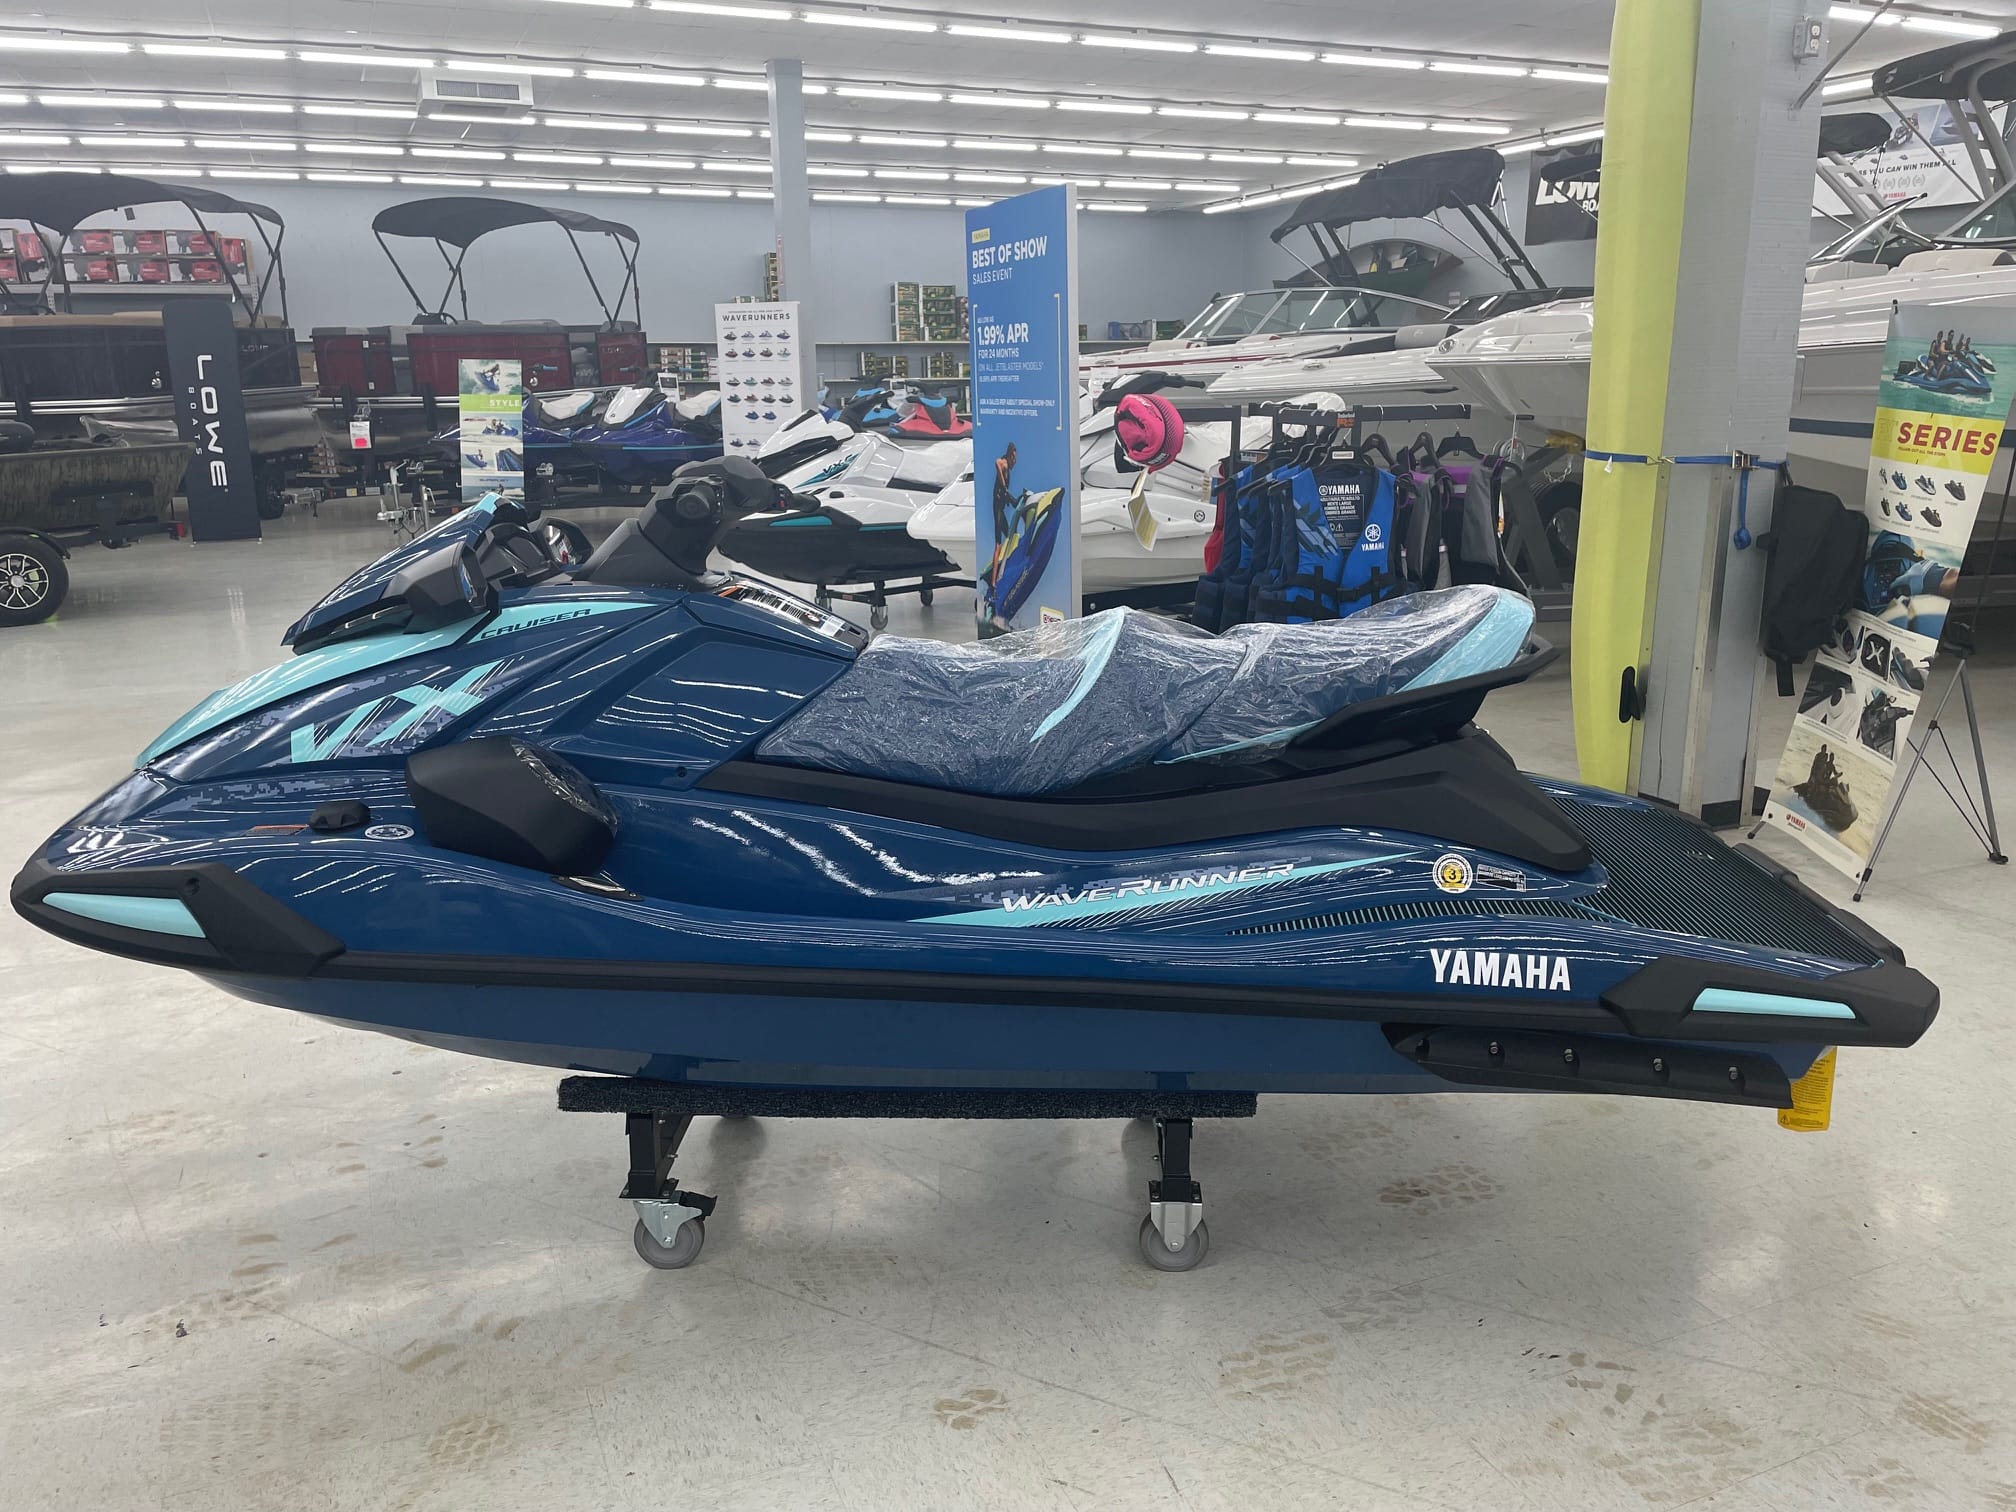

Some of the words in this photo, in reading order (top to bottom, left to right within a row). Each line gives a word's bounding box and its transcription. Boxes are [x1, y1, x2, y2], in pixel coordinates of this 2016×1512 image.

[972, 246, 996, 269] BEST
[998, 243, 1012, 264] OF
[1014, 235, 1047, 261] SHOW
[973, 271, 992, 285] SALES
[992, 267, 1013, 282] EVENT
[722, 312, 791, 321] WAVERUNNERS
[977, 324, 1005, 346] 1.99%
[1006, 322, 1029, 344] APR
[978, 349, 989, 359] FOR
[989, 348, 996, 359] 24
[996, 347, 1020, 358] MONTHS
[489, 399, 520, 408] STYLE
[188, 386, 203, 455] BOATS
[197, 354, 228, 486] LOWE
[1897, 422, 1997, 456] SERIES
[1328, 484, 1360, 495] YAMAHA
[1361, 541, 1385, 552] YAMAHA
[480, 608, 591, 640] CRUISER
[291, 659, 504, 764] VX
[1002, 863, 1294, 913] WAVERUNNER
[1448, 868, 1457, 880] 3
[1430, 949, 1571, 992] YAMAHA
